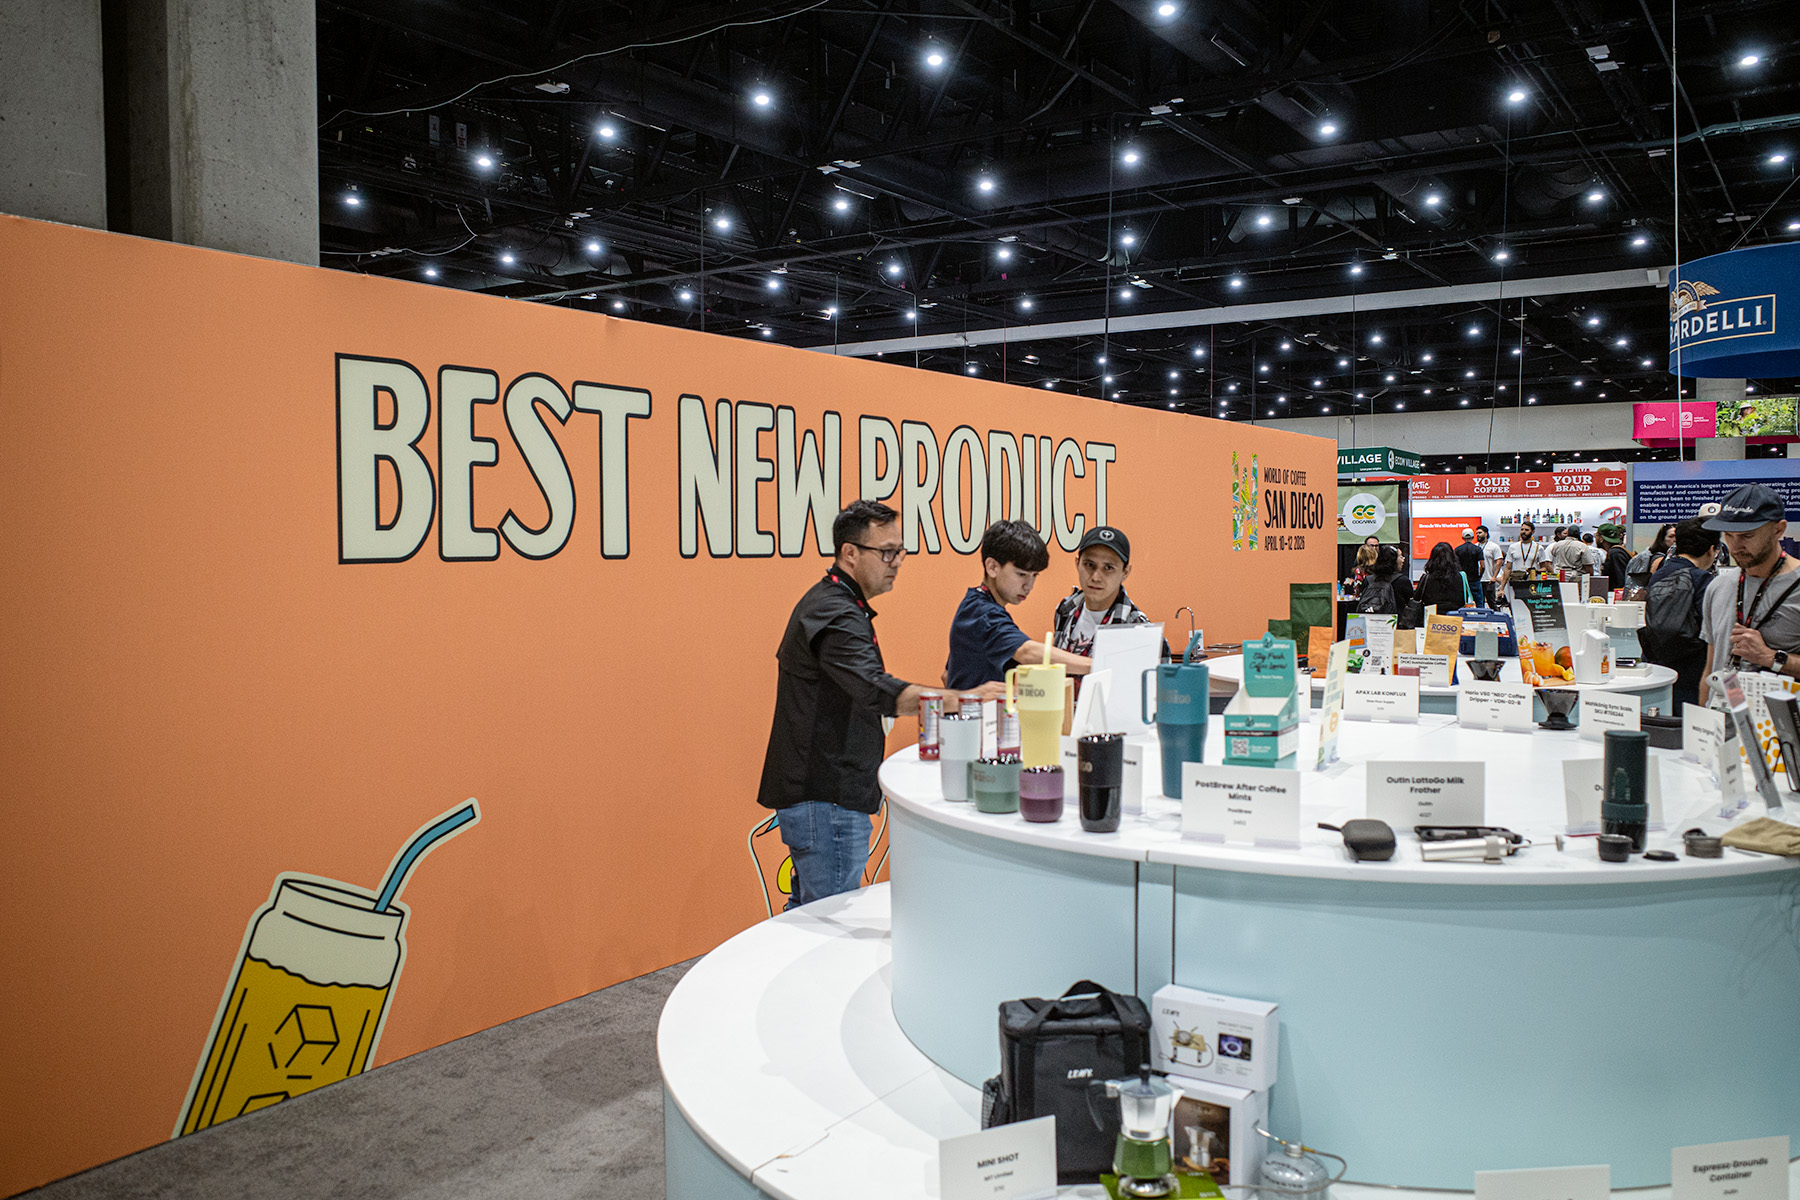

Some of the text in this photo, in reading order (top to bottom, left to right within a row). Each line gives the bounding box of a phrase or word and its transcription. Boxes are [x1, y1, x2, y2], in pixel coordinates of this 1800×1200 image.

[335, 352, 1116, 565] BEST NEW PRODUCT
[1337, 454, 1382, 465] VILLAGE
[1264, 467, 1306, 486] WORLD OF COFFEE
[1473, 477, 1510, 486] YOUR
[1552, 475, 1592, 485] YOUR
[1264, 489, 1323, 529] SAN DIEGO
[1264, 536, 1278, 550] APRIL
[1432, 623, 1458, 633] ROSSO
[1585, 701, 1608, 709] Mahlkönig
[1196, 780, 1234, 790] PostBrew
[1258, 785, 1286, 793] Coffee
[1228, 793, 1252, 801] Mints
[977, 1152, 1019, 1168] MINI SHOT
[1693, 1158, 1768, 1173] Espresso Grounds
[1709, 1171, 1752, 1182] Container
